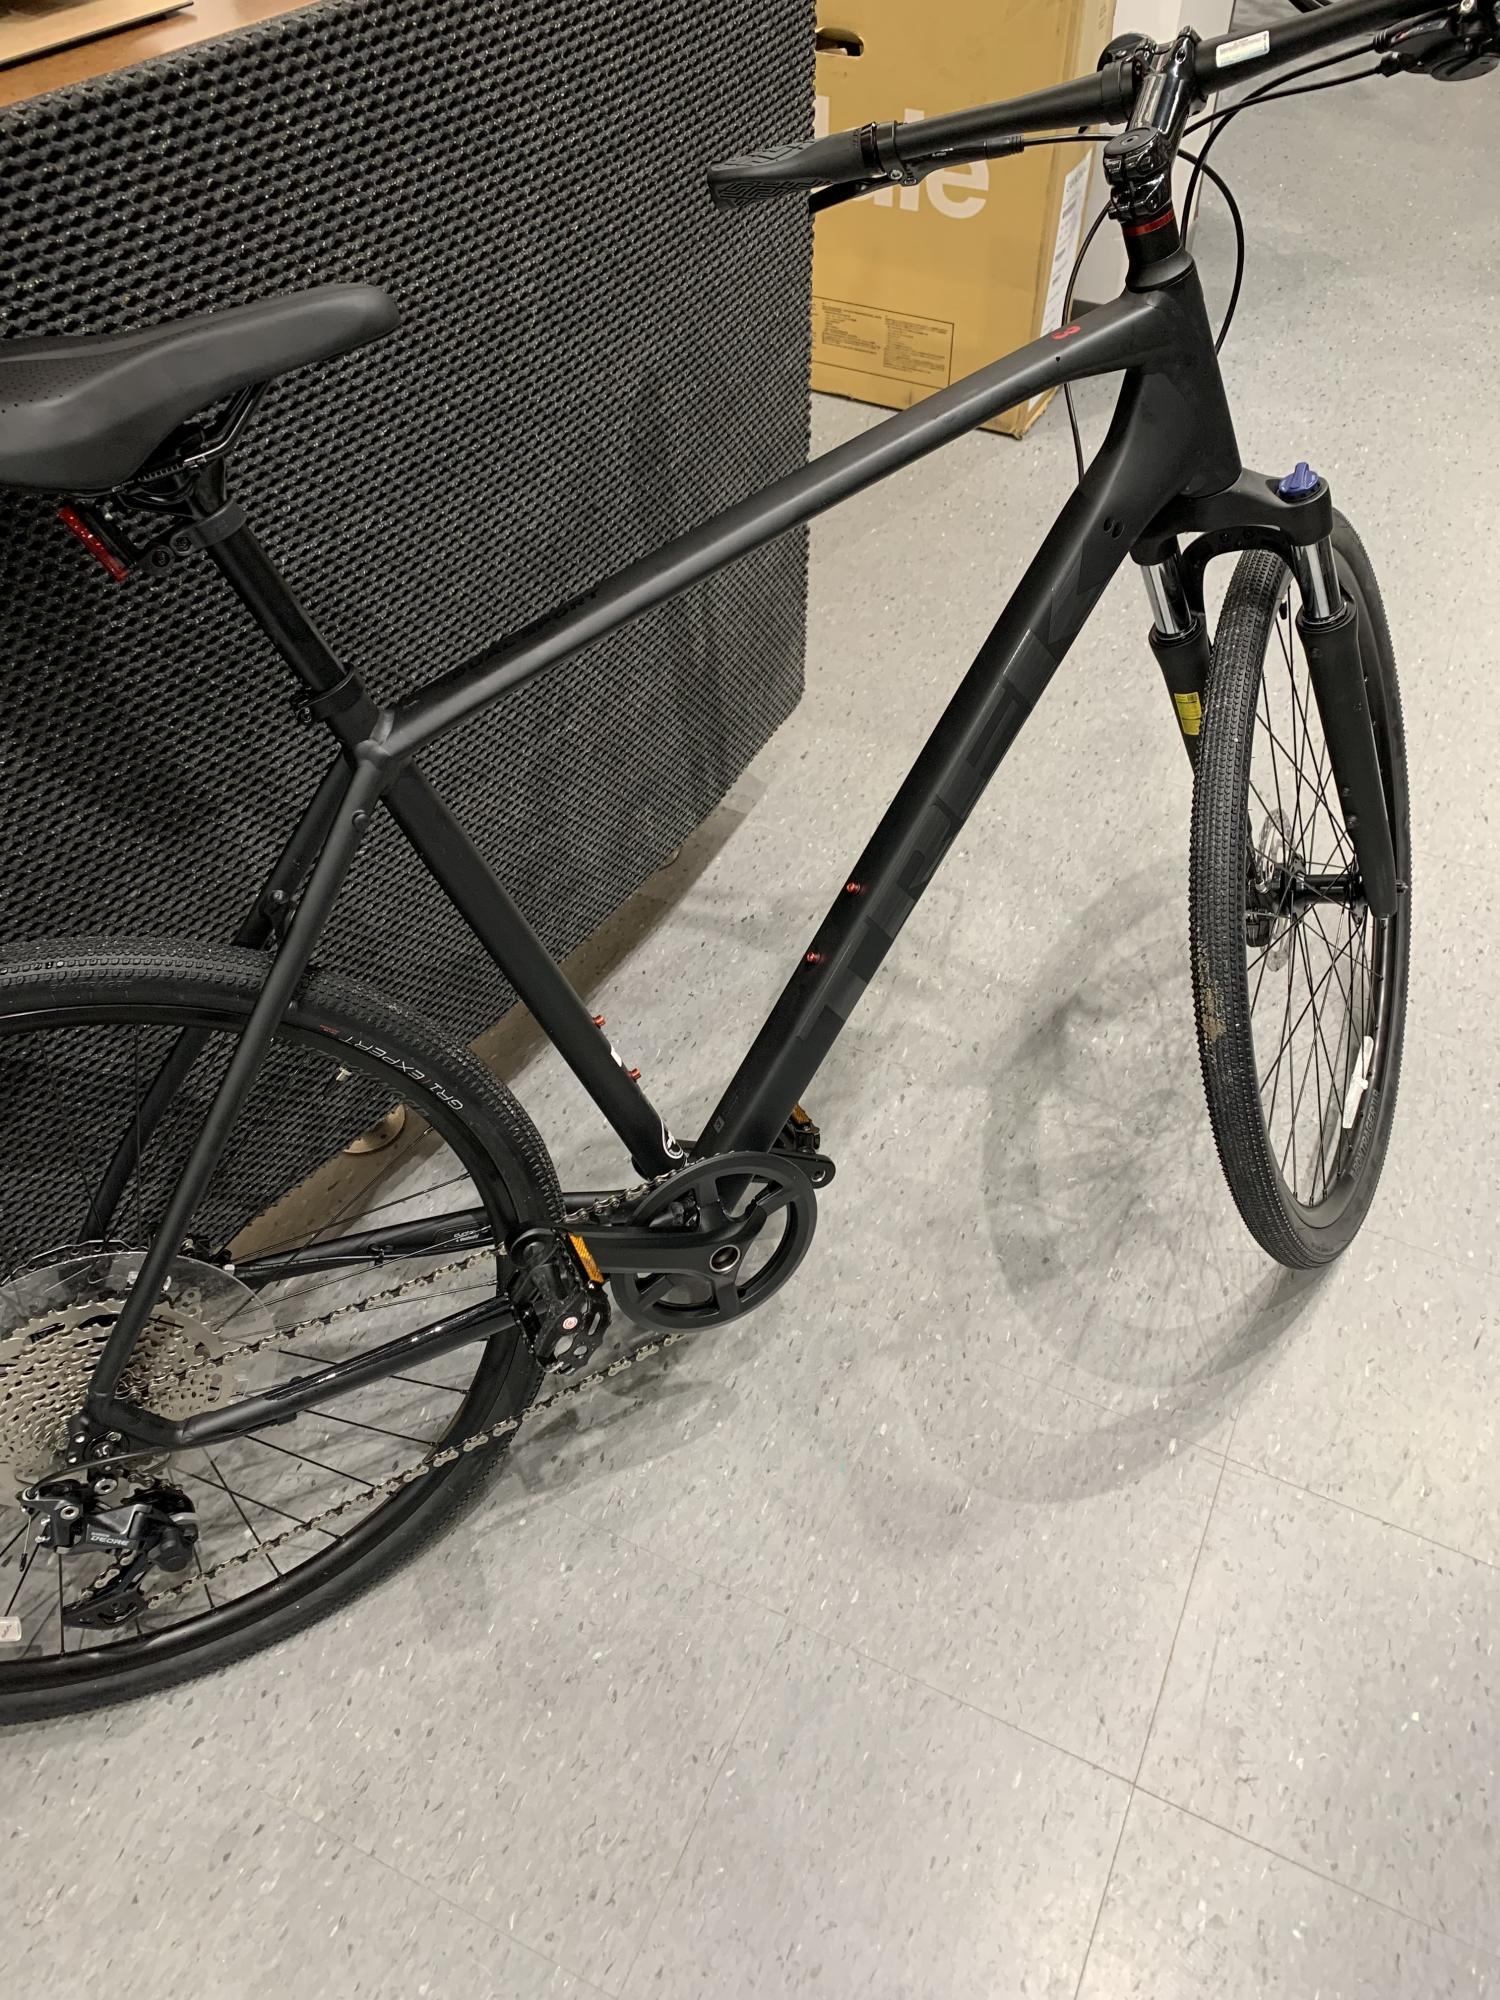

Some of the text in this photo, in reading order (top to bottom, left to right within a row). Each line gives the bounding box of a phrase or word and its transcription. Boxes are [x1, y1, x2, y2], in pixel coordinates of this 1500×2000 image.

[793, 541, 1104, 1041] TREK
[338, 1035, 426, 1080] EXPERT
[90, 1535, 130, 1546] DEORE
